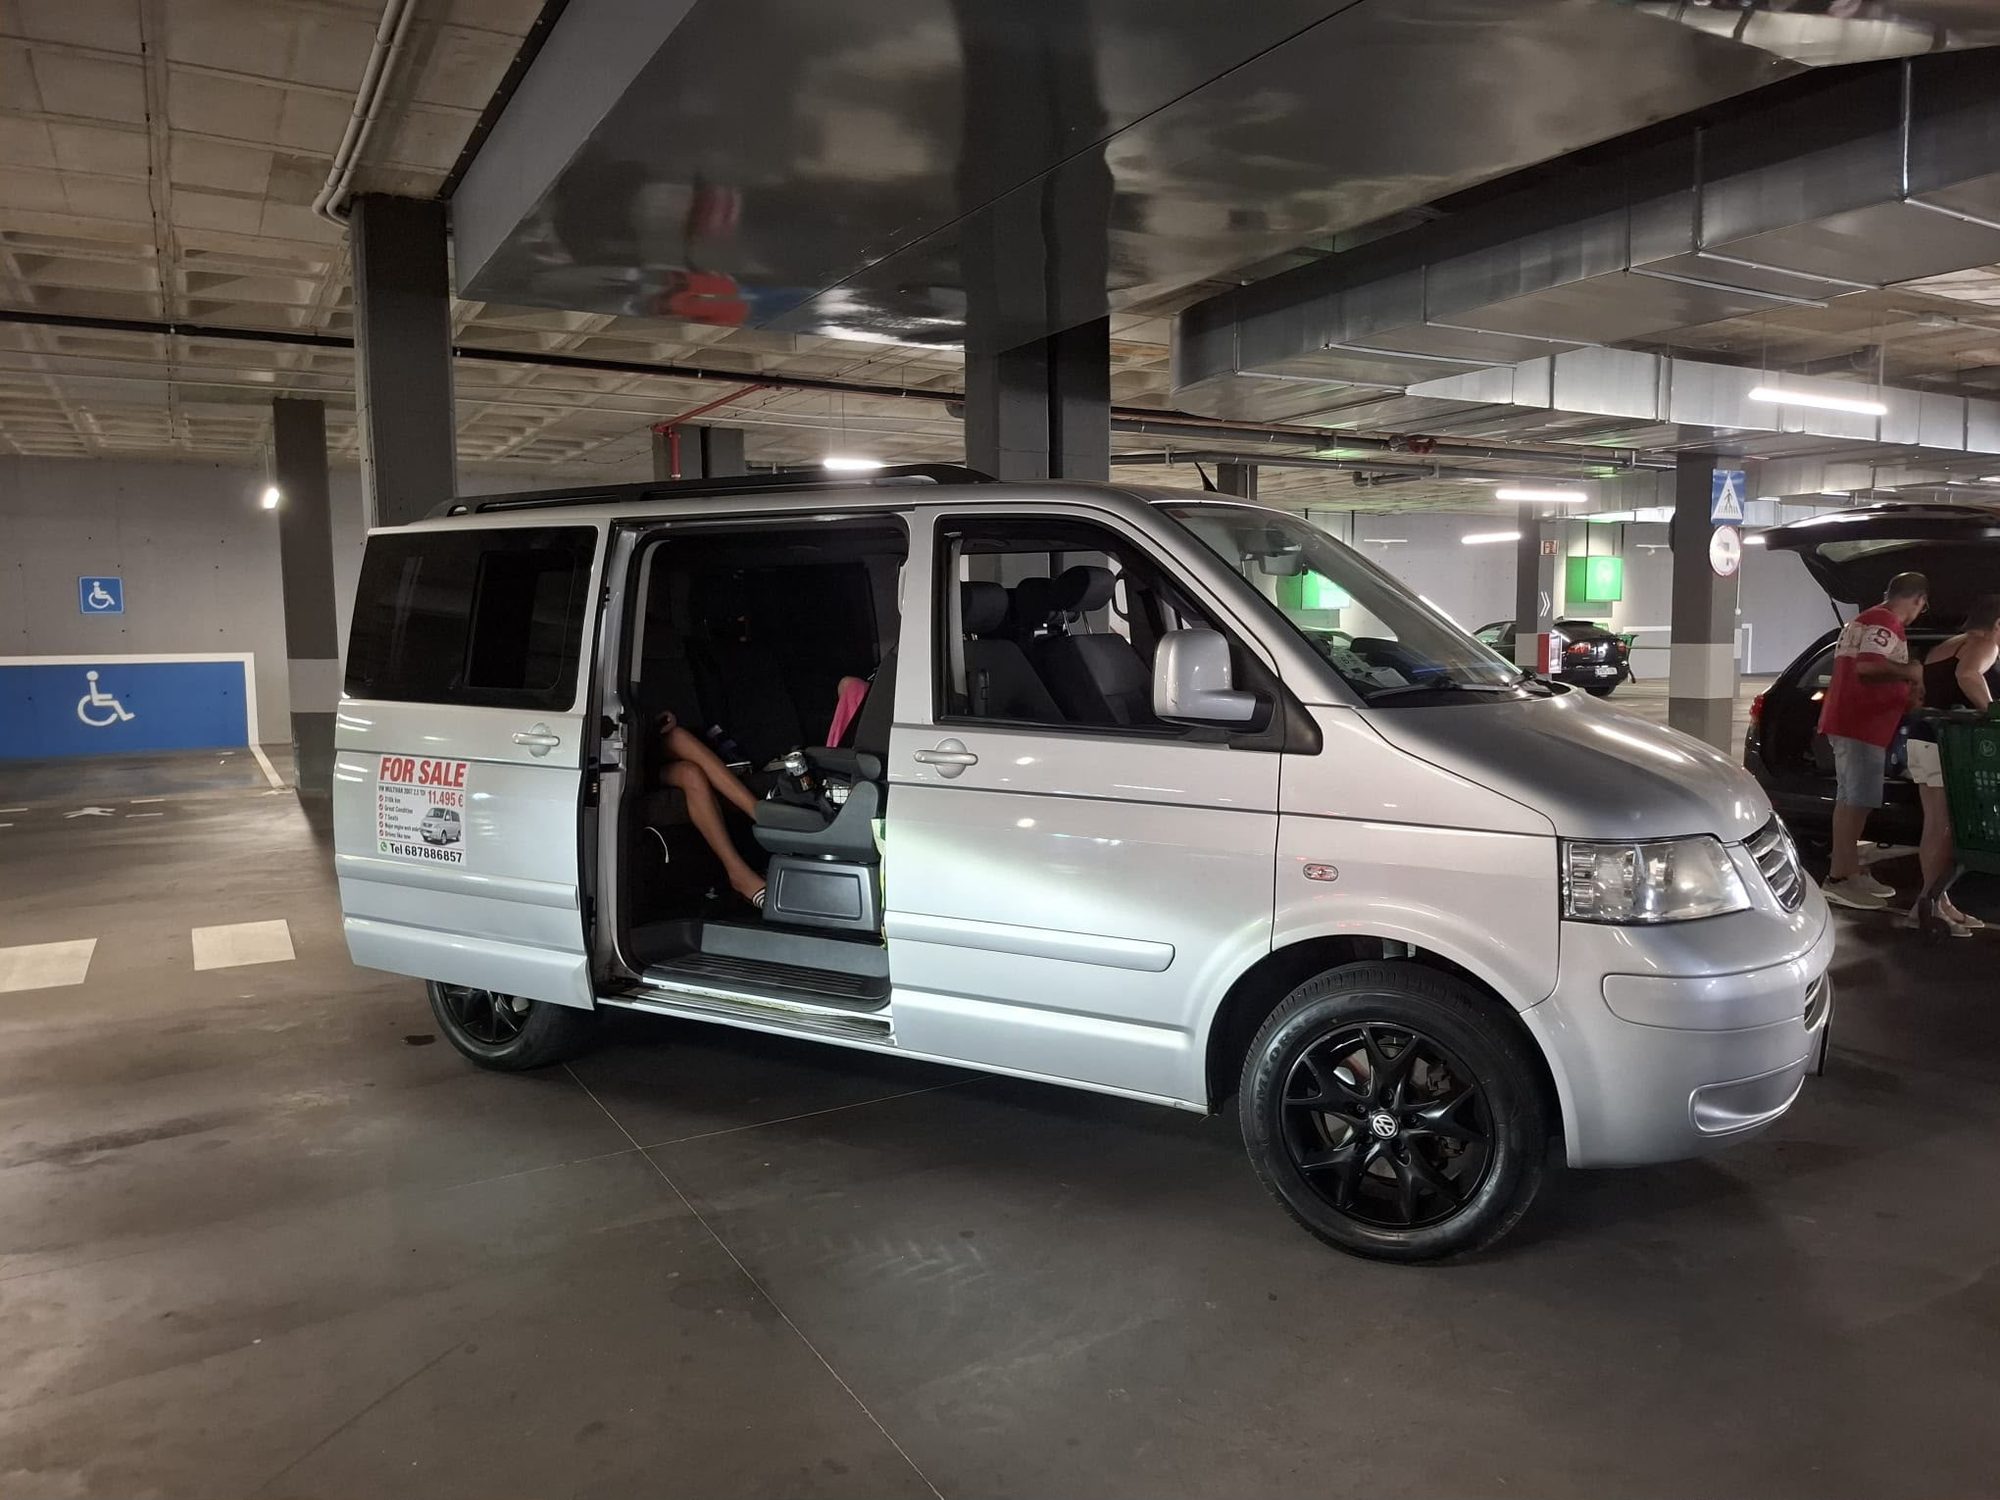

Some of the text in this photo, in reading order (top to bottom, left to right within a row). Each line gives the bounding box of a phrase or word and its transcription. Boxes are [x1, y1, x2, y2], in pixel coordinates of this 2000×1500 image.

[380, 757, 466, 788] FOR SALE
[428, 790, 464, 807] 11.495 €
[390, 843, 462, 863] Tel 687886857
